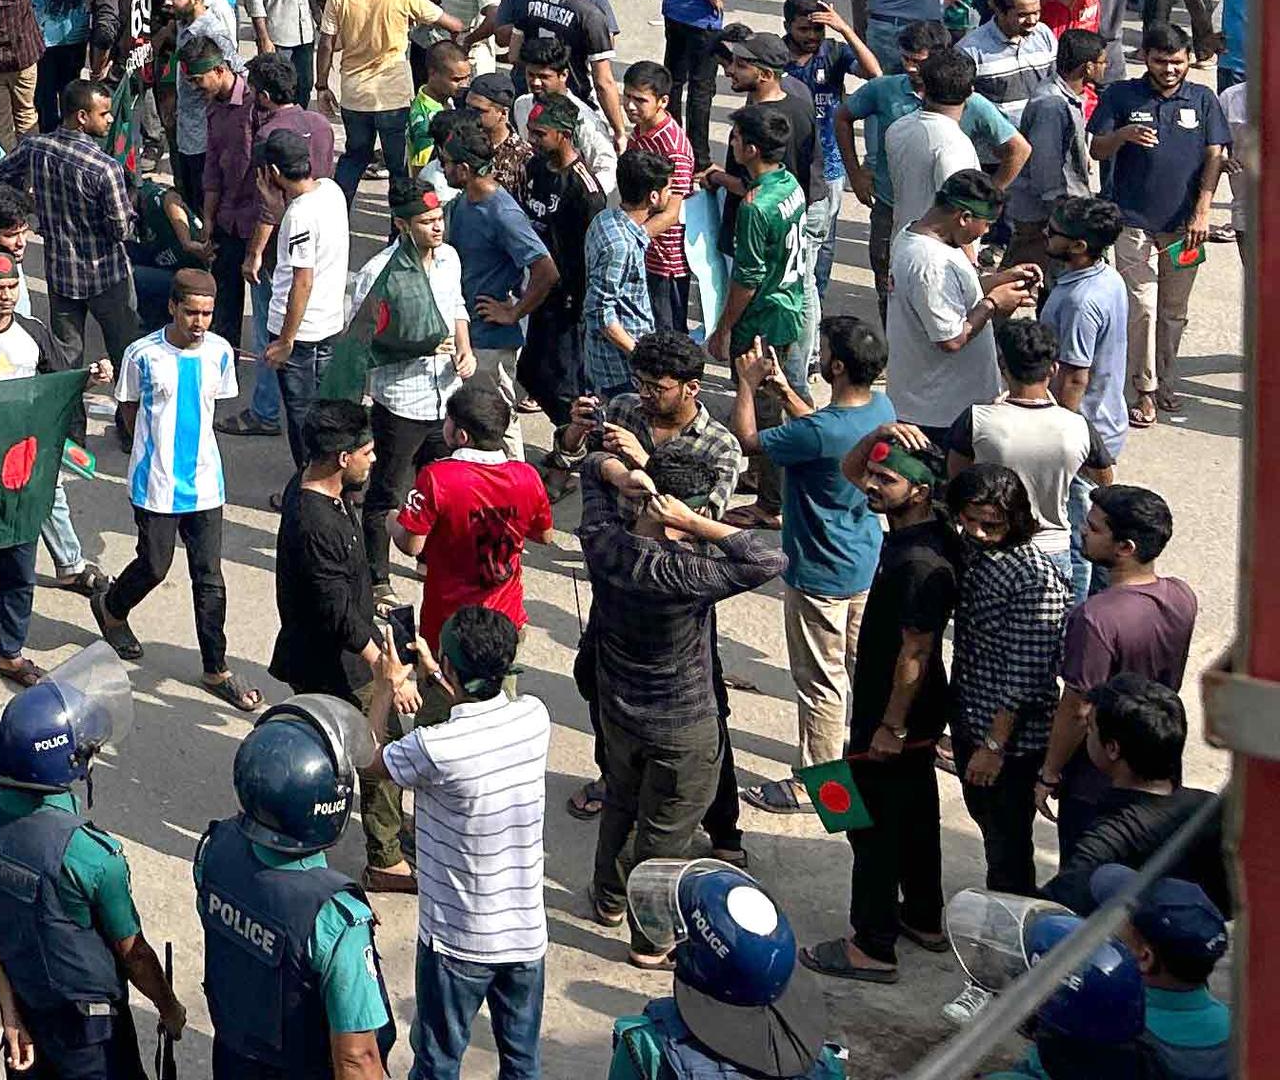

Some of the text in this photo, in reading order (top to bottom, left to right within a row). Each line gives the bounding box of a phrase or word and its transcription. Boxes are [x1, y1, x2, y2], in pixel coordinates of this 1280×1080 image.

[34, 733, 70, 752] POLICE
[313, 798, 346, 816] POLICE
[208, 892, 276, 956] POLICE
[691, 908, 730, 960] POLICE
